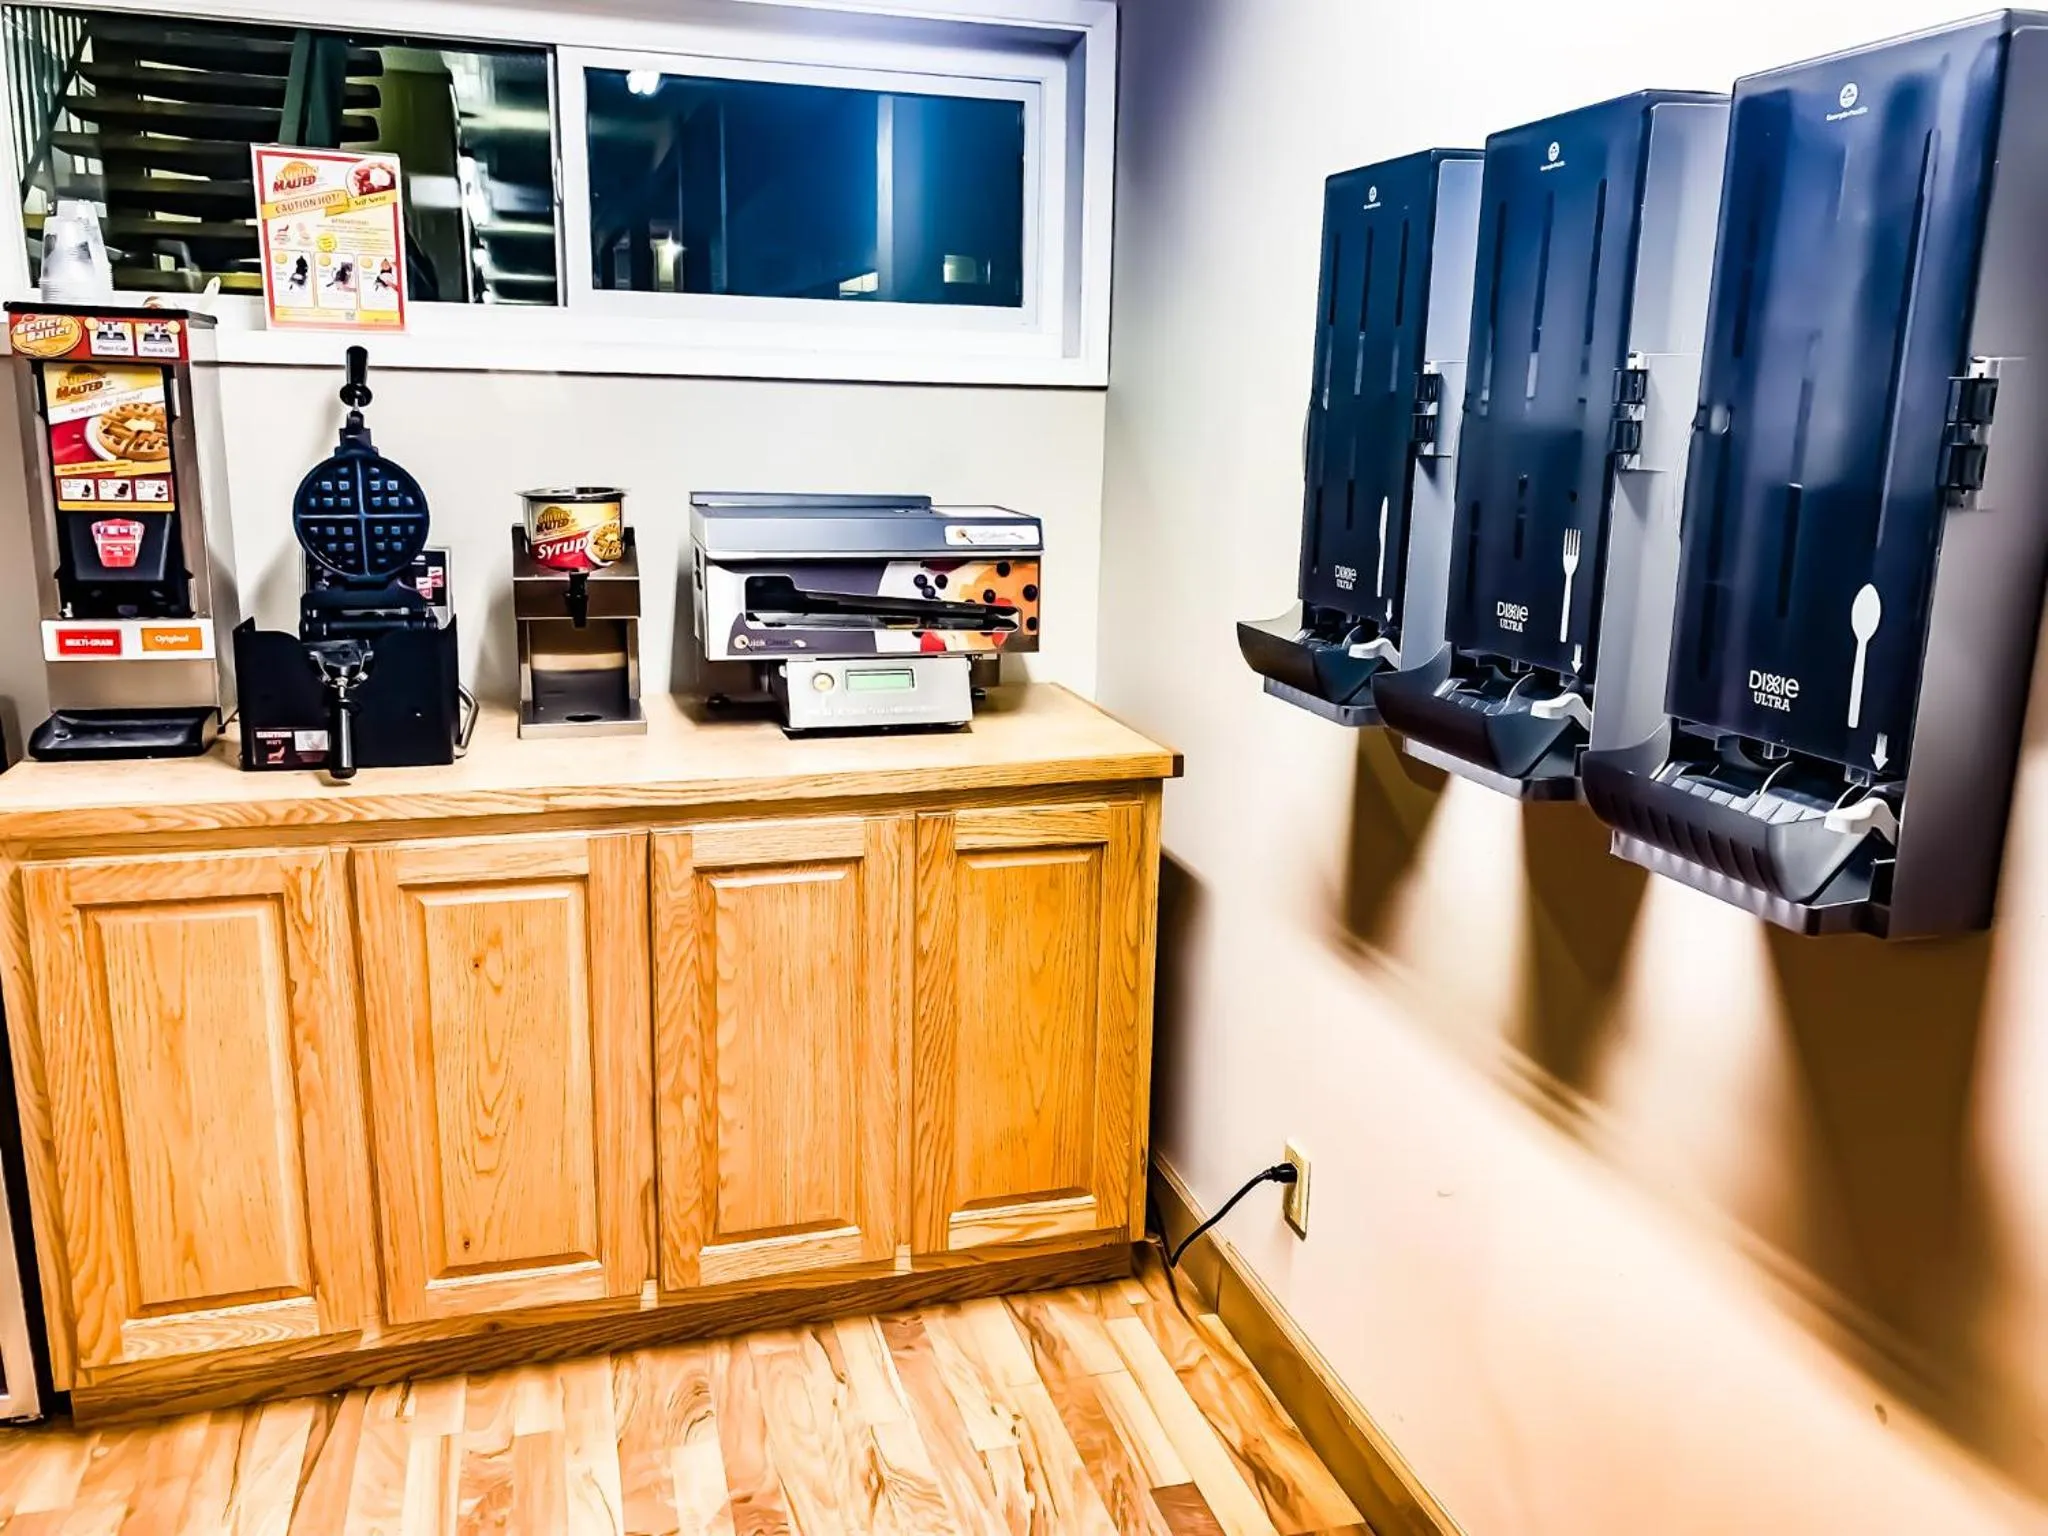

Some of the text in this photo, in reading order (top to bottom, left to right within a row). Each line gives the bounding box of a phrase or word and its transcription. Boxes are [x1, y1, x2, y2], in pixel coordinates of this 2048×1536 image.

[273, 175, 317, 192] MALTED
[275, 200, 316, 214] CAUTION
[56, 380, 104, 400] MALTED
[537, 536, 587, 560] Syrup
[1500, 617, 1523, 633] ULTRA
[65, 638, 114, 647] MULTI-GRAIN
[154, 634, 189, 645] Original
[1753, 691, 1790, 712] ULTRA
